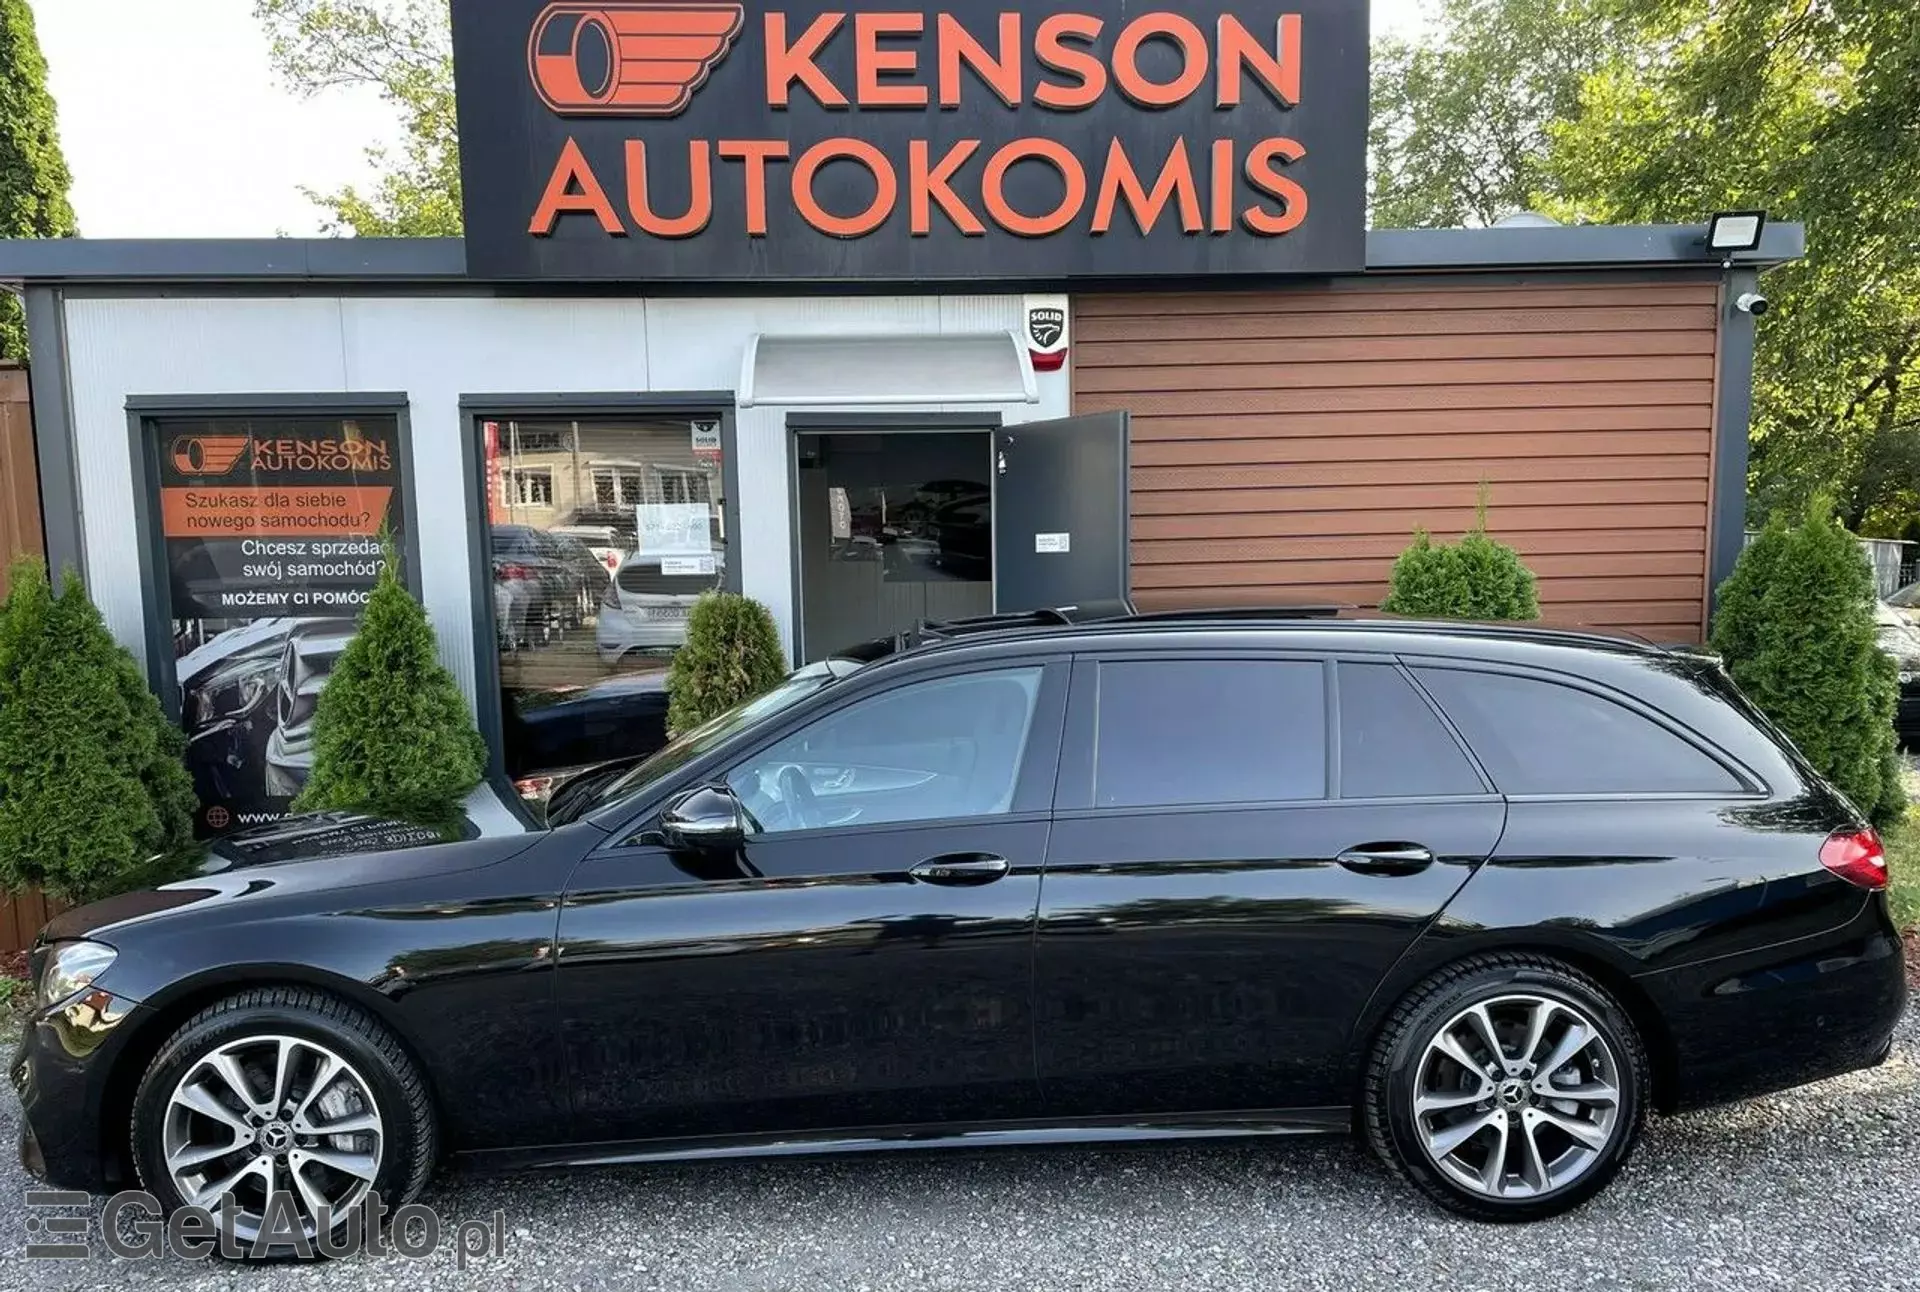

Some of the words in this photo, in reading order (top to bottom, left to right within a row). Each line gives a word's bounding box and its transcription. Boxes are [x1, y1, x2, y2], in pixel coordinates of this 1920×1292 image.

[763, 12, 1302, 110] KENSON
[527, 136, 1309, 238] AUTOKOMIS
[1030, 311, 1062, 321] SOLID
[253, 439, 387, 455] KENSON
[251, 455, 391, 471] AUTOKOMIS
[185, 492, 258, 509] Szukasz
[264, 491, 290, 508] dla
[295, 491, 346, 507] siebie
[186, 514, 255, 532] nowego
[260, 512, 370, 528] samochodu?
[241, 540, 307, 556] Chcesz
[242, 562, 283, 580] swój
[287, 559, 386, 577] samochód?
[221, 590, 288, 606] MOŻEMY
[293, 592, 309, 604] CI
